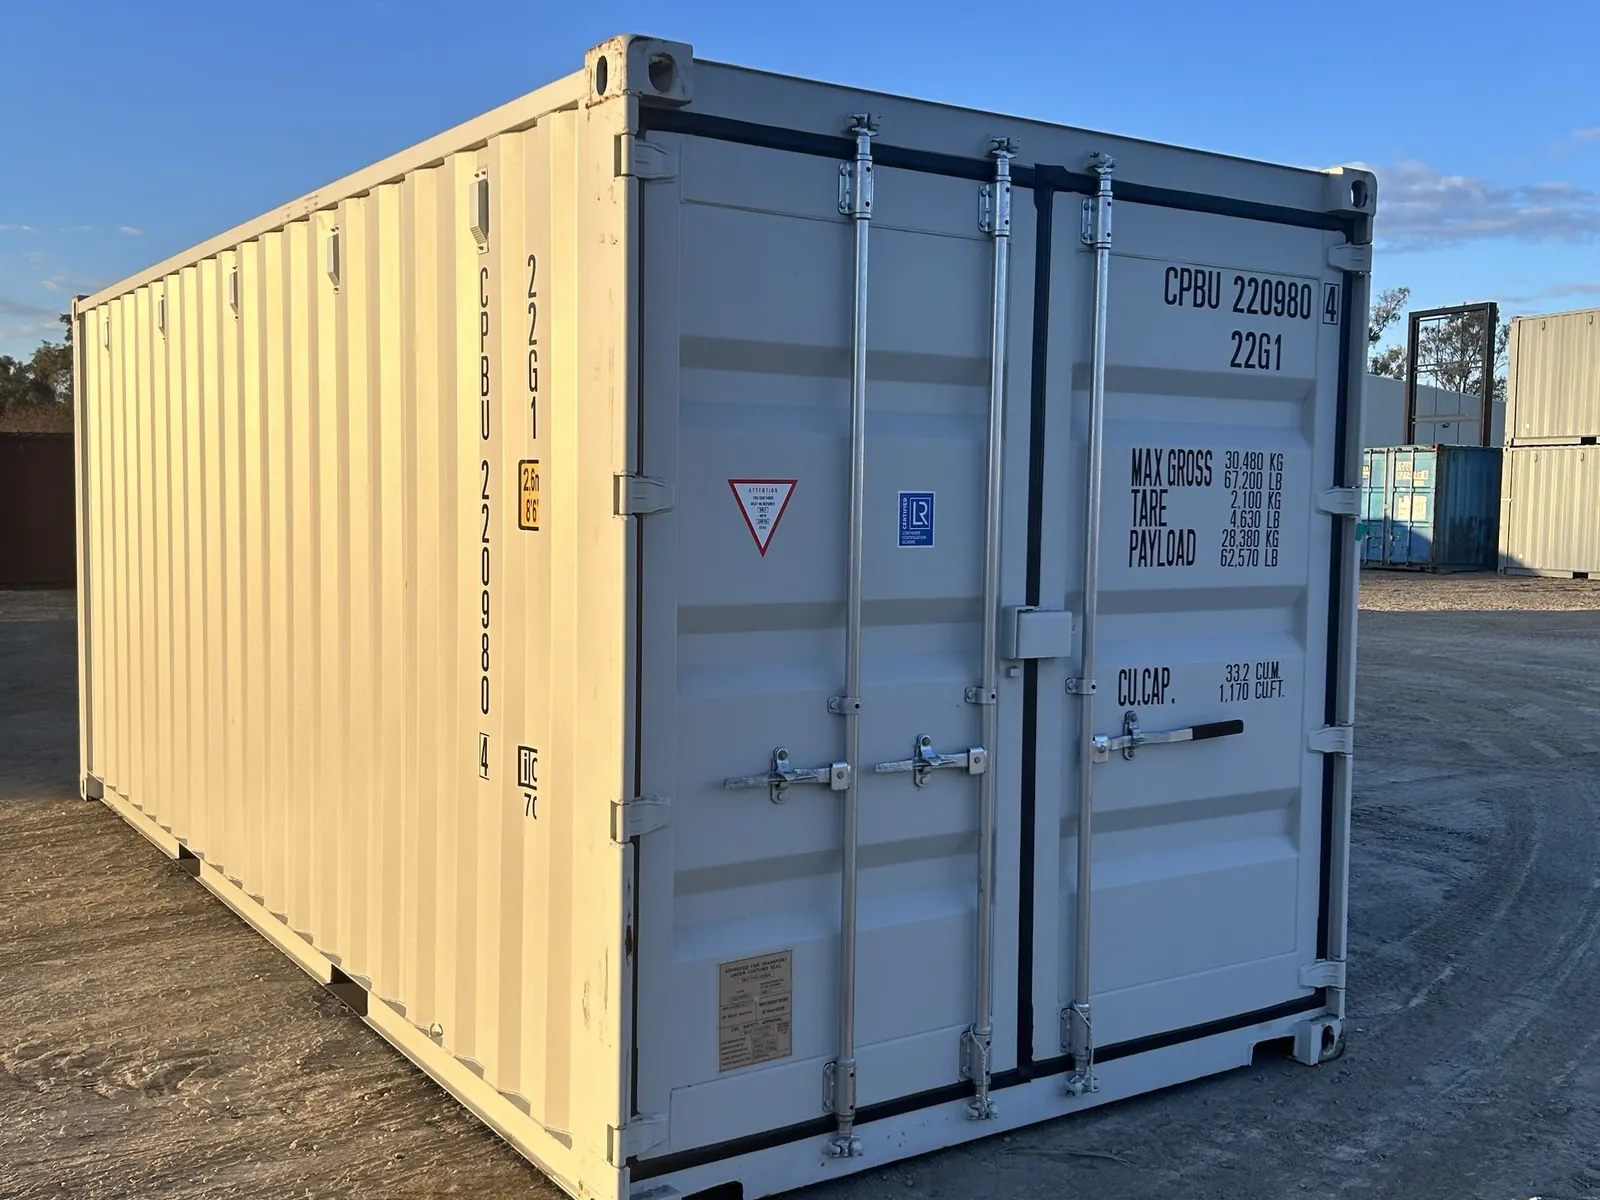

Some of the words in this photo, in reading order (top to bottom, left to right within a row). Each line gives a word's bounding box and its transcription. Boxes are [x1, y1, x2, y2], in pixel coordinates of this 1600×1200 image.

[1163, 266, 1221, 310] CPBU
[1232, 275, 1312, 320] 220980
[1325, 286, 1337, 322] 4
[480, 266, 490, 441] CPBU
[527, 254, 538, 440] 22G1
[1230, 330, 1282, 371] 22G1
[1131, 448, 1163, 487] MAX
[1167, 448, 1213, 487] GROSS
[1225, 450, 1264, 471] 30,480
[1269, 453, 1284, 472] KG
[1224, 471, 1263, 491] 67,200
[1268, 471, 1283, 491] LB
[1131, 489, 1168, 527] TARE
[1231, 490, 1262, 510] 2,100
[1267, 491, 1282, 510] KG
[1229, 510, 1261, 529] 4,630
[1266, 510, 1280, 529] LB
[1128, 529, 1197, 568] PAYLOAD
[1221, 529, 1260, 549] 28,380
[1265, 530, 1279, 548] KG
[1220, 549, 1259, 568] 62,570
[1264, 549, 1278, 567] LB
[480, 459, 490, 715] 220980
[1219, 682, 1249, 703] 1,170
[1225, 663, 1250, 683] 33.2
